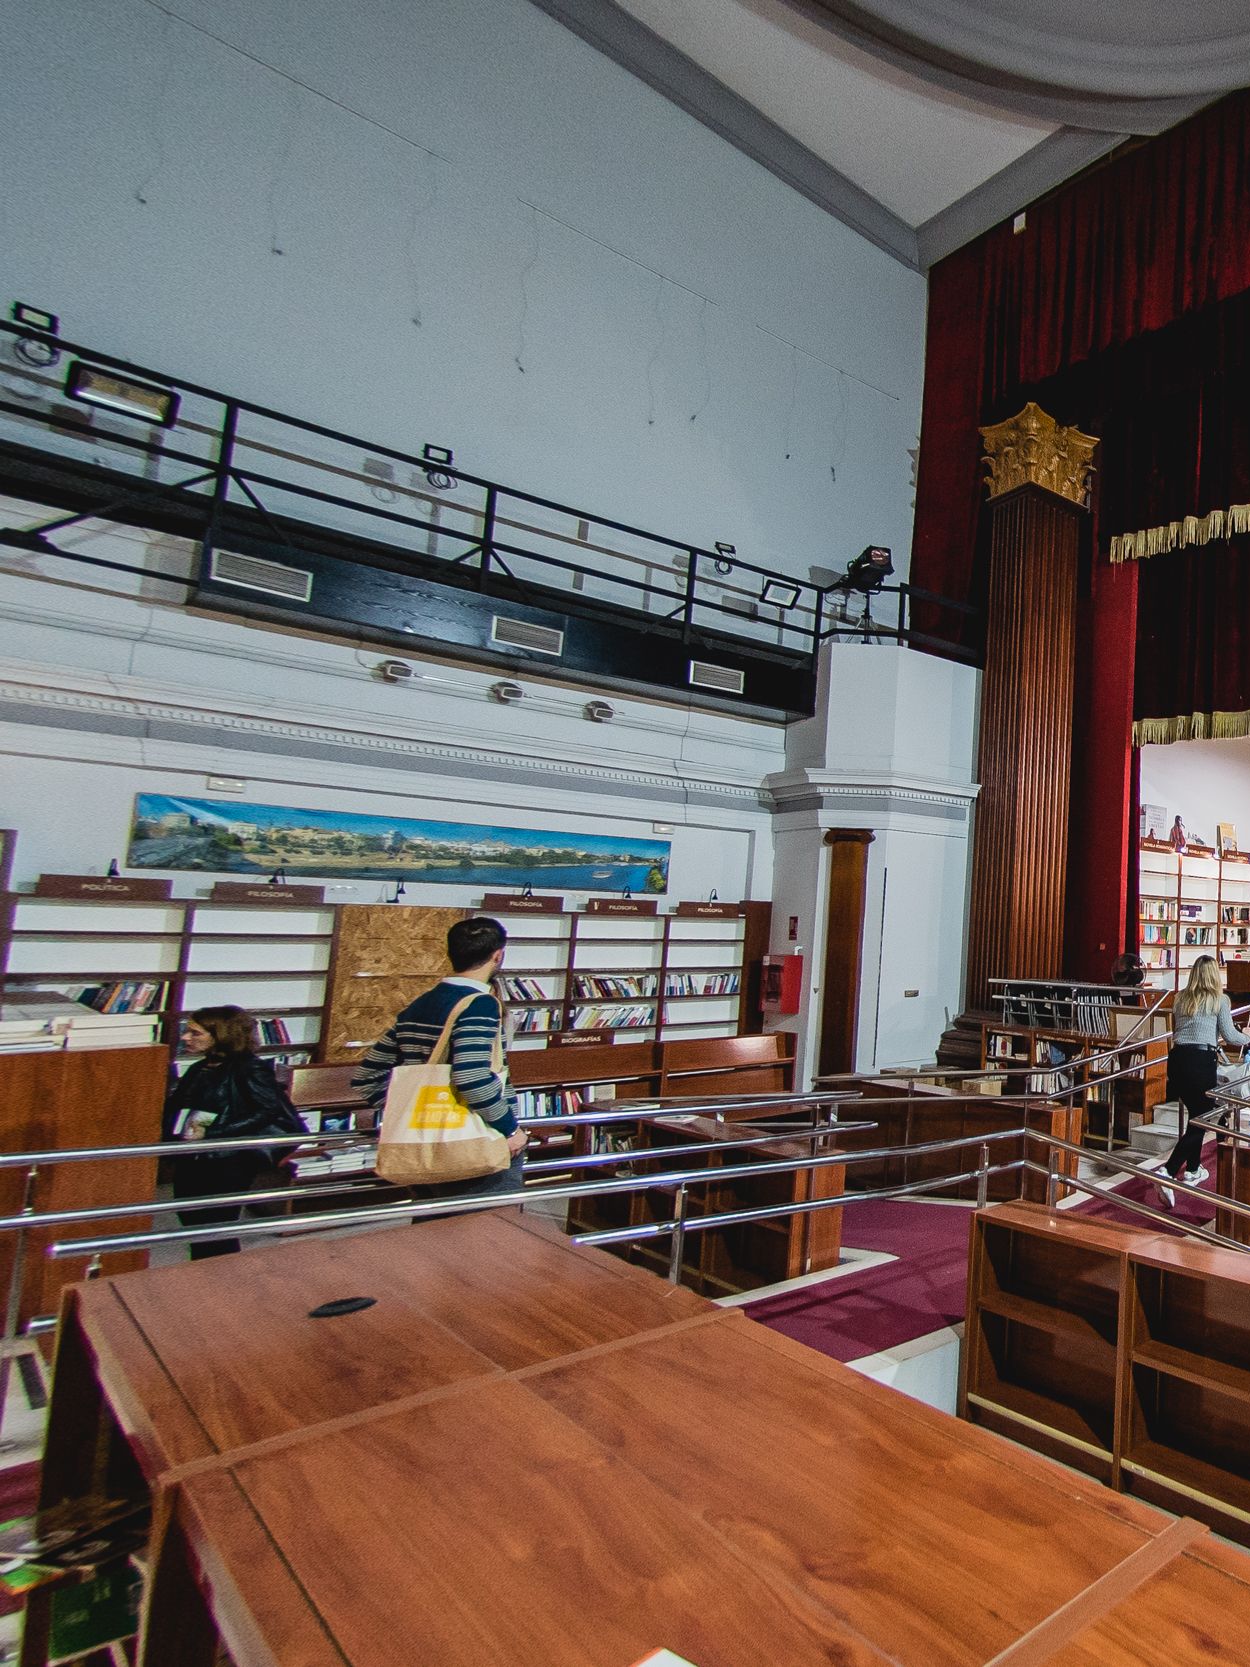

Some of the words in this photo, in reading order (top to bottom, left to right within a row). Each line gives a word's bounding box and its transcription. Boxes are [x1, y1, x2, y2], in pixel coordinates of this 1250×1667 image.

[81, 883, 130, 892] POLÍTICA
[509, 900, 543, 908] FILOSOFÍA
[561, 1035, 602, 1044] BIOGRAFÍAS
